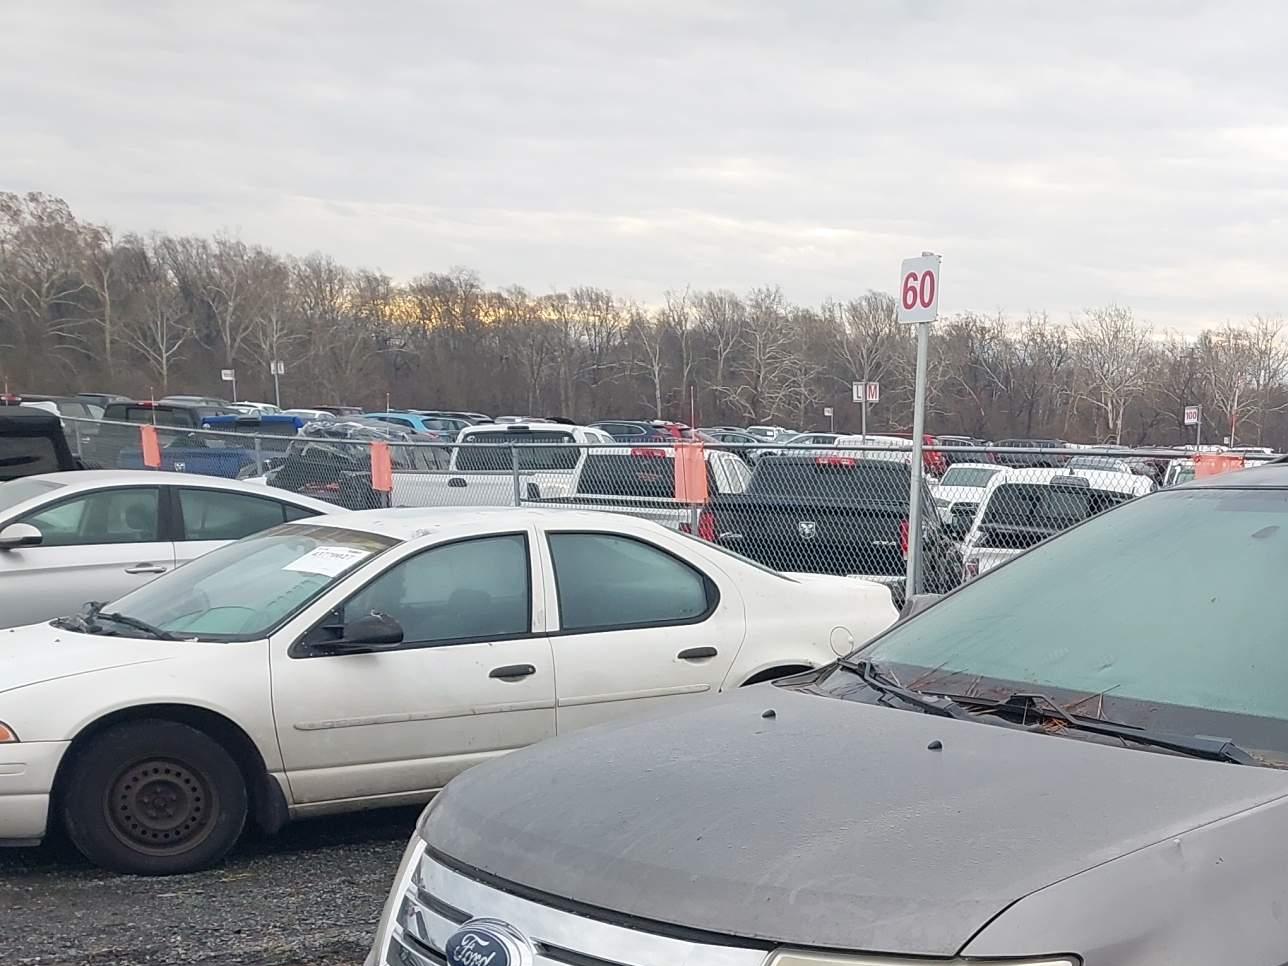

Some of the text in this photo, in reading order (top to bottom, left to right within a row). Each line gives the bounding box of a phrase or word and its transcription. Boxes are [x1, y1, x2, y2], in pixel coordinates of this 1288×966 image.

[902, 269, 936, 311] 60
[868, 384, 878, 400] M
[1186, 411, 1197, 420] 100
